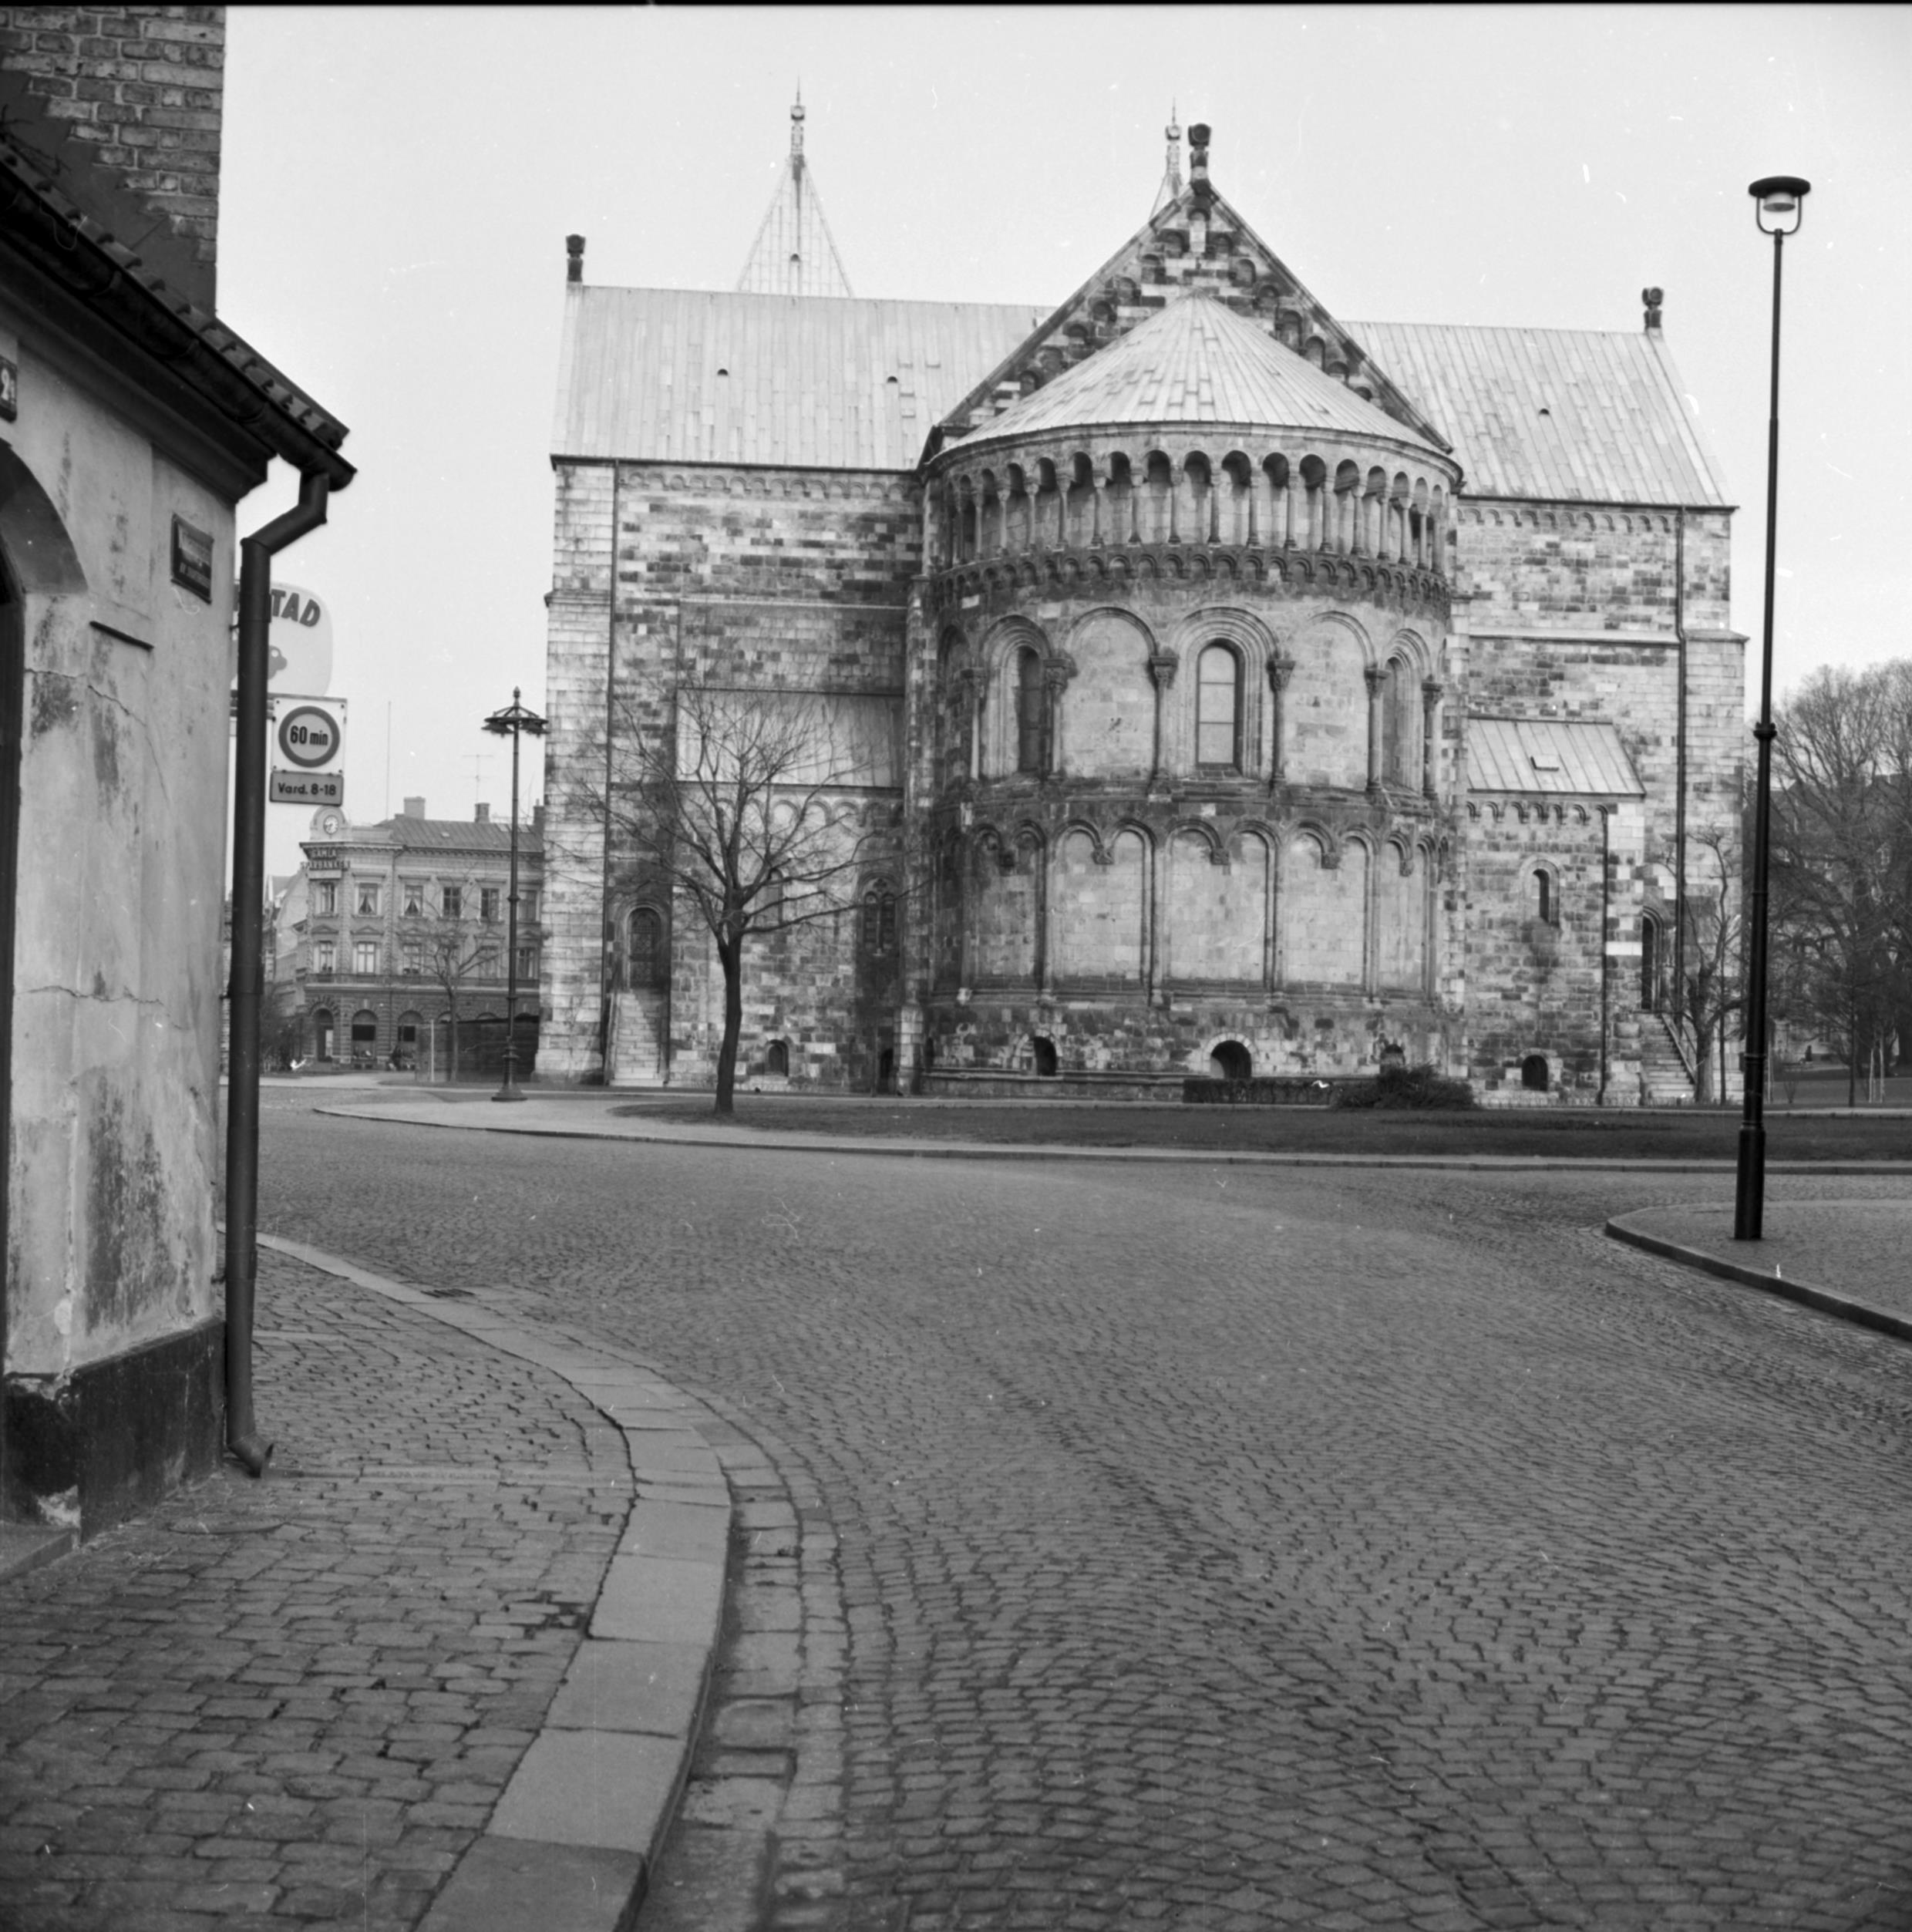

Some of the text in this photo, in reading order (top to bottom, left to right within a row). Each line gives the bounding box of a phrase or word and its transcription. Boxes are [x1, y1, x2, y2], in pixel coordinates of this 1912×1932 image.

[271, 588, 321, 628] TAD
[290, 725, 328, 746] 60 min
[278, 782, 337, 796] Vard. 8-18
